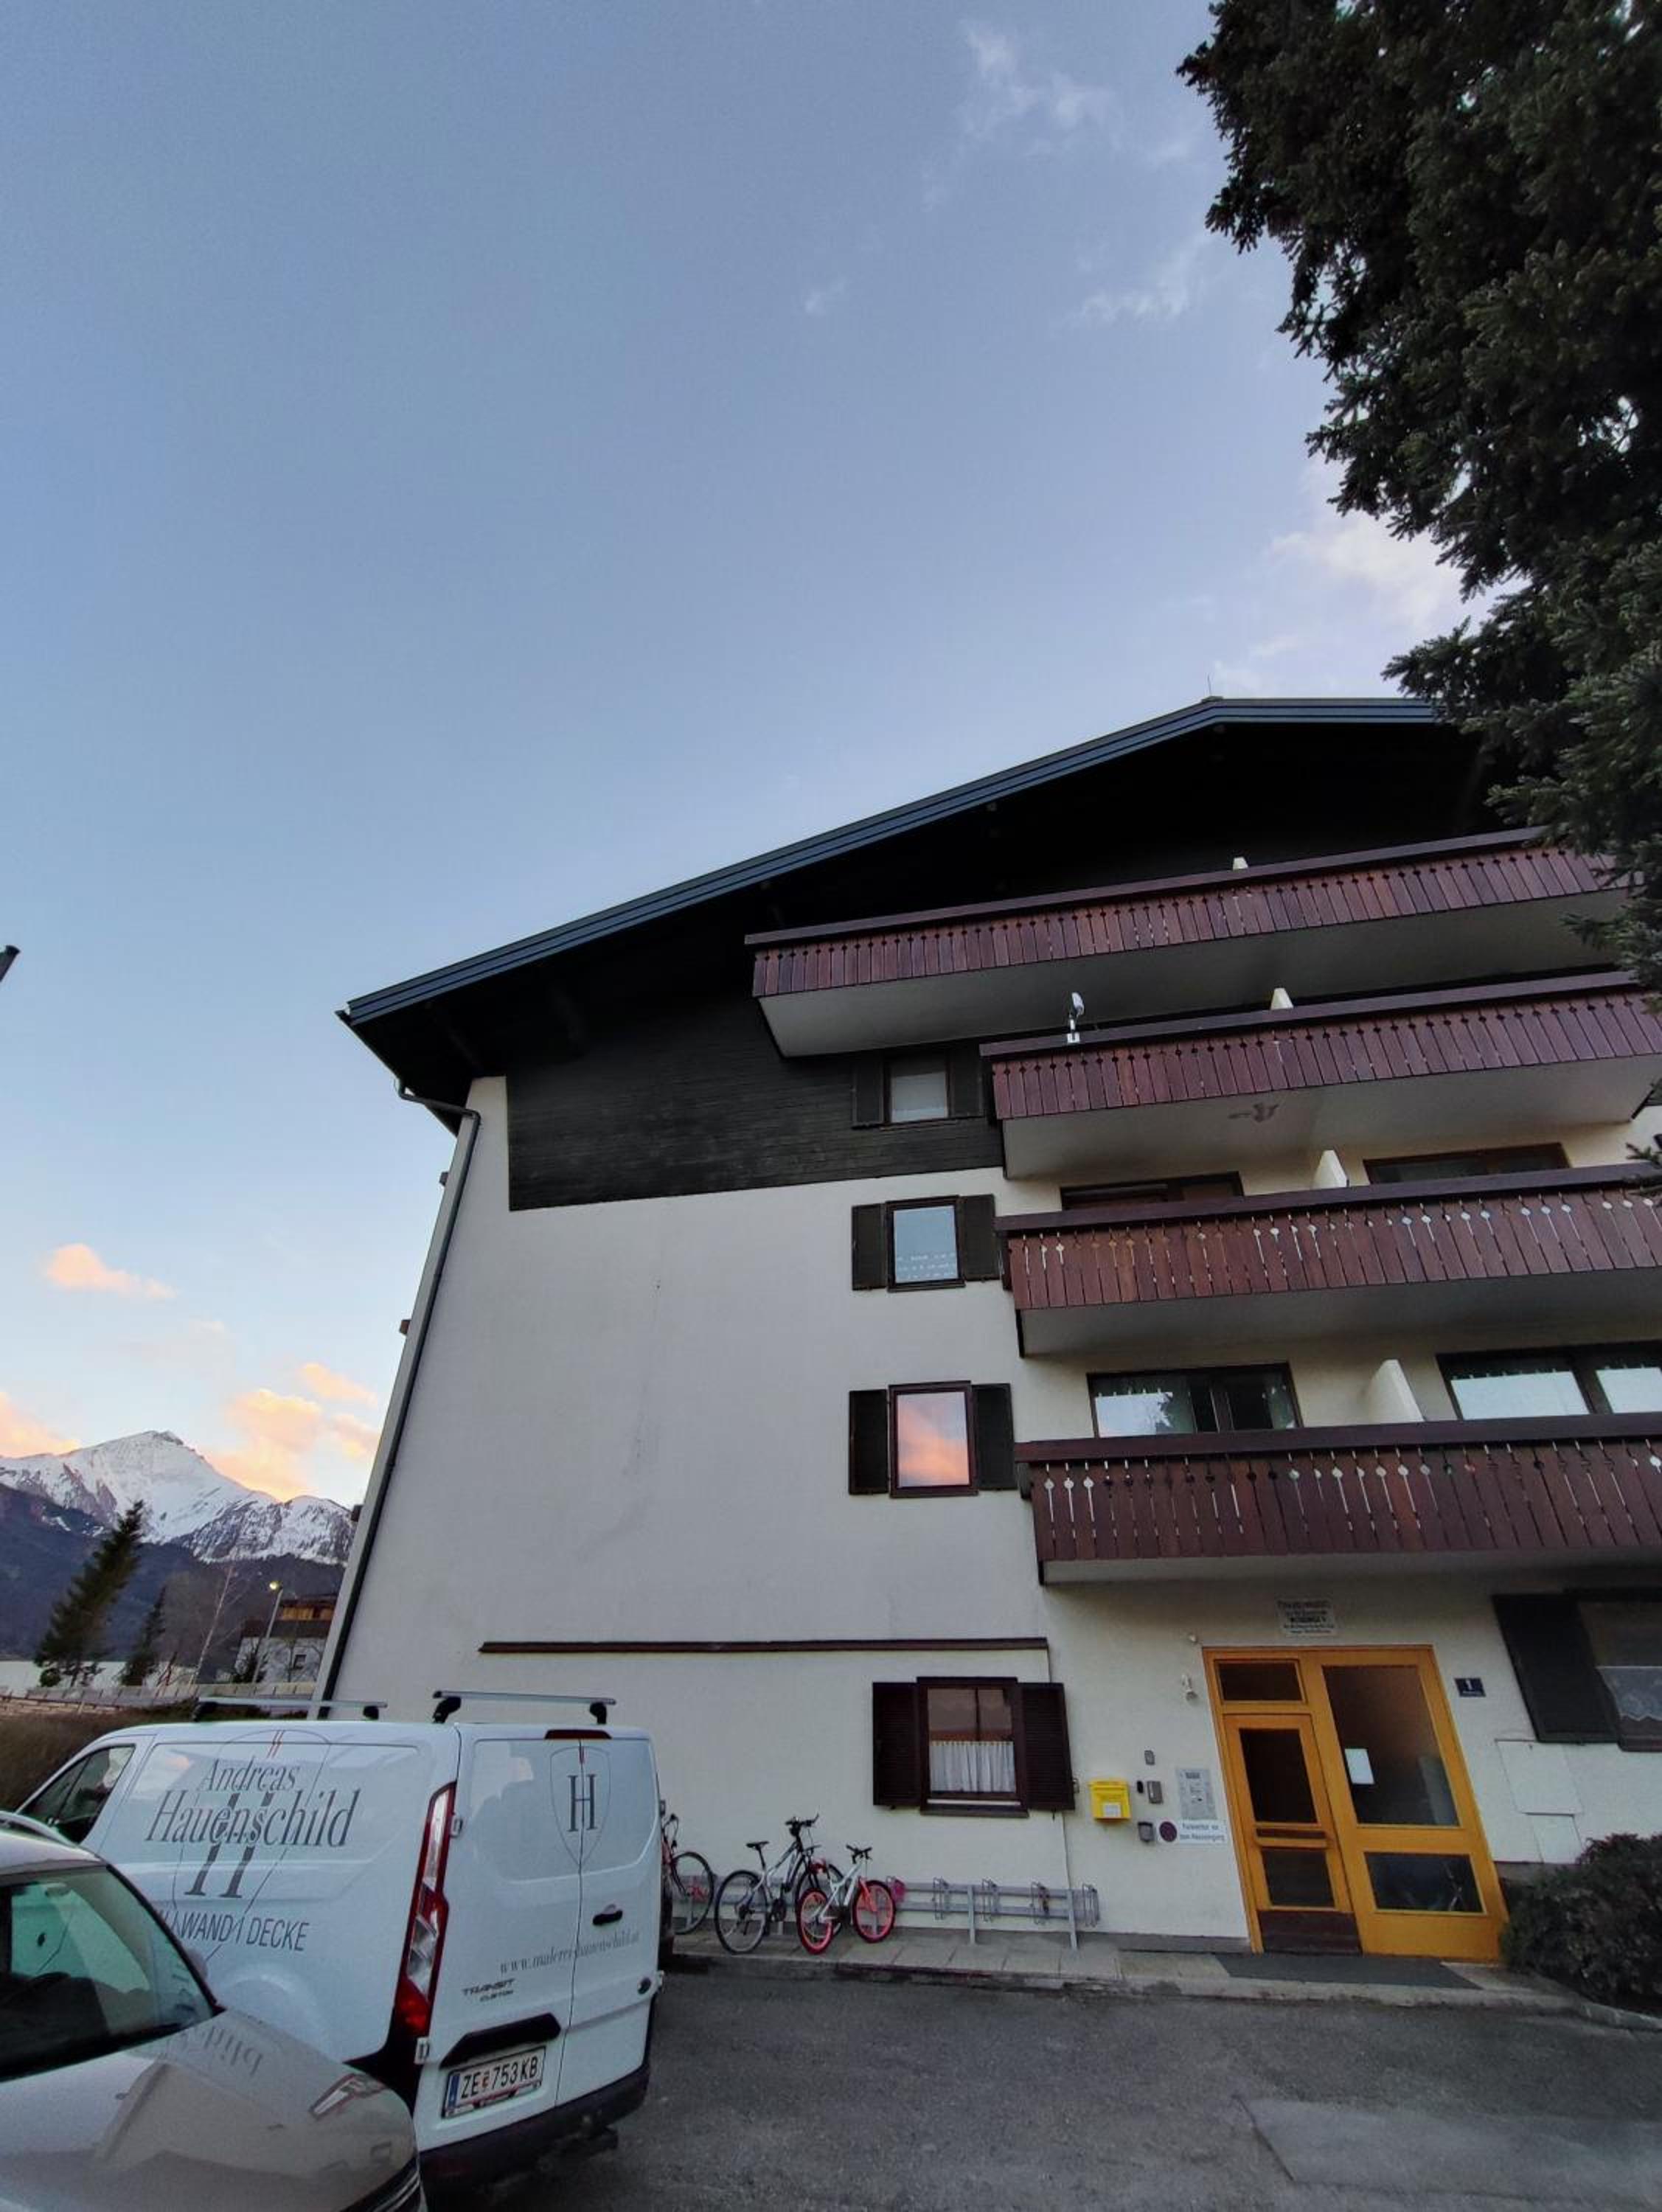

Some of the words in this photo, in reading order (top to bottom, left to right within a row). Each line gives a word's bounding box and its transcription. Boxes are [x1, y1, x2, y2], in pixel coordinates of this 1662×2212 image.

[201, 1755, 300, 1792] Andreas
[145, 1787, 361, 1848] Hauenschild
[567, 1774, 597, 1832] H
[181, 1910, 232, 1943] WAND
[246, 1917, 310, 1952] DECKE
